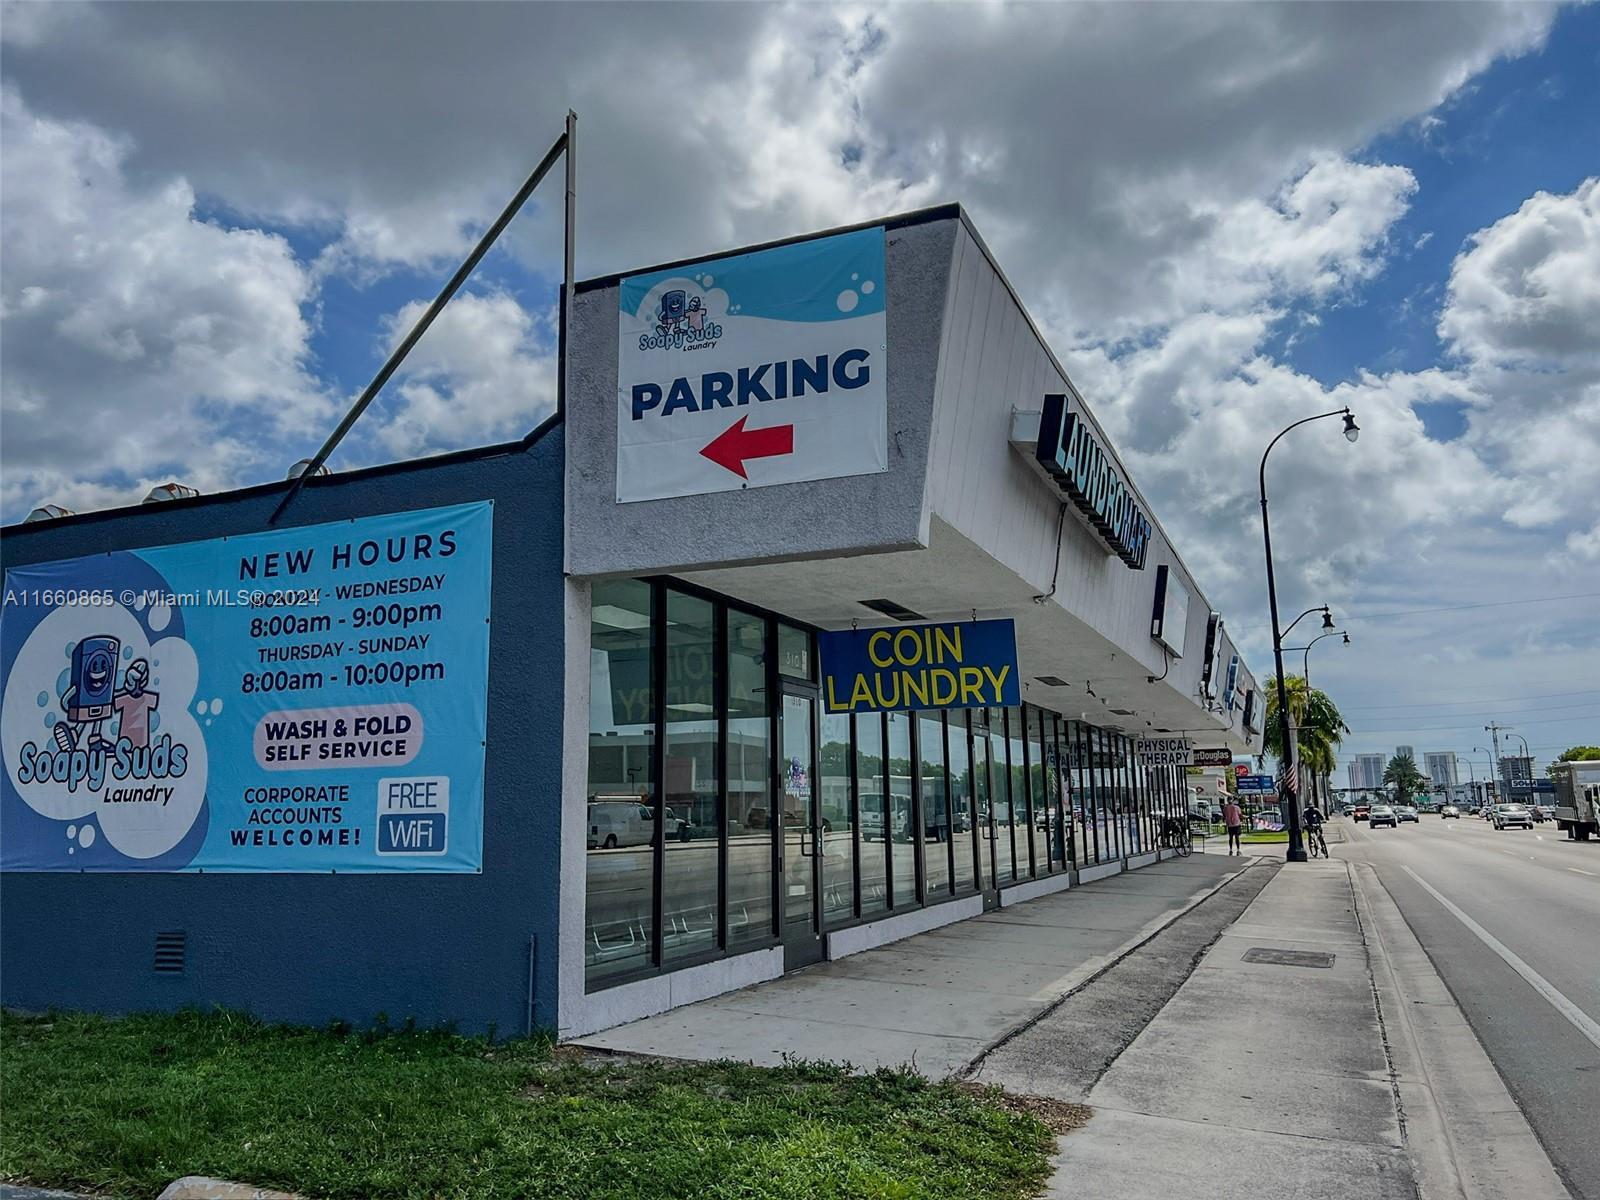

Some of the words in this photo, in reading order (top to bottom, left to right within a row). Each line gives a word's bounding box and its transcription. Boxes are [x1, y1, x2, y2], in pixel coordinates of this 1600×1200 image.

[639, 332, 683, 351] Soapy
[686, 322, 722, 343] Suds
[683, 341, 717, 352] Laundry
[631, 349, 871, 421] PARKING
[239, 548, 313, 580] NEW
[332, 530, 457, 569] HOURS
[335, 574, 446, 600] WEDNESDAY
[250, 614, 331, 638] 8:00am
[352, 603, 442, 628] 9:00pm
[258, 642, 345, 663] THURSDAY
[358, 634, 431, 655] SUNDAY
[868, 626, 963, 668] COIN
[241, 670, 323, 693] 8:00am
[344, 661, 445, 687] 10:00pm
[827, 665, 1010, 711] LAUNDRY
[265, 720, 327, 741] WASH
[333, 719, 348, 737] &
[354, 715, 412, 737] FOLD
[265, 744, 311, 762] SELF
[319, 740, 407, 760] SERVICE
[1137, 740, 1190, 752] PHYSICAL
[1140, 752, 1190, 764] THERAPY
[18, 741, 106, 793] Soapy
[112, 733, 188, 780] Suds
[103, 784, 175, 806] Laundry
[244, 786, 349, 803] CORPORATE
[388, 782, 438, 809] FREE
[248, 807, 342, 825] ACCOUNTS
[231, 829, 361, 846] WELCOME!
[388, 820, 433, 848] WiFi
